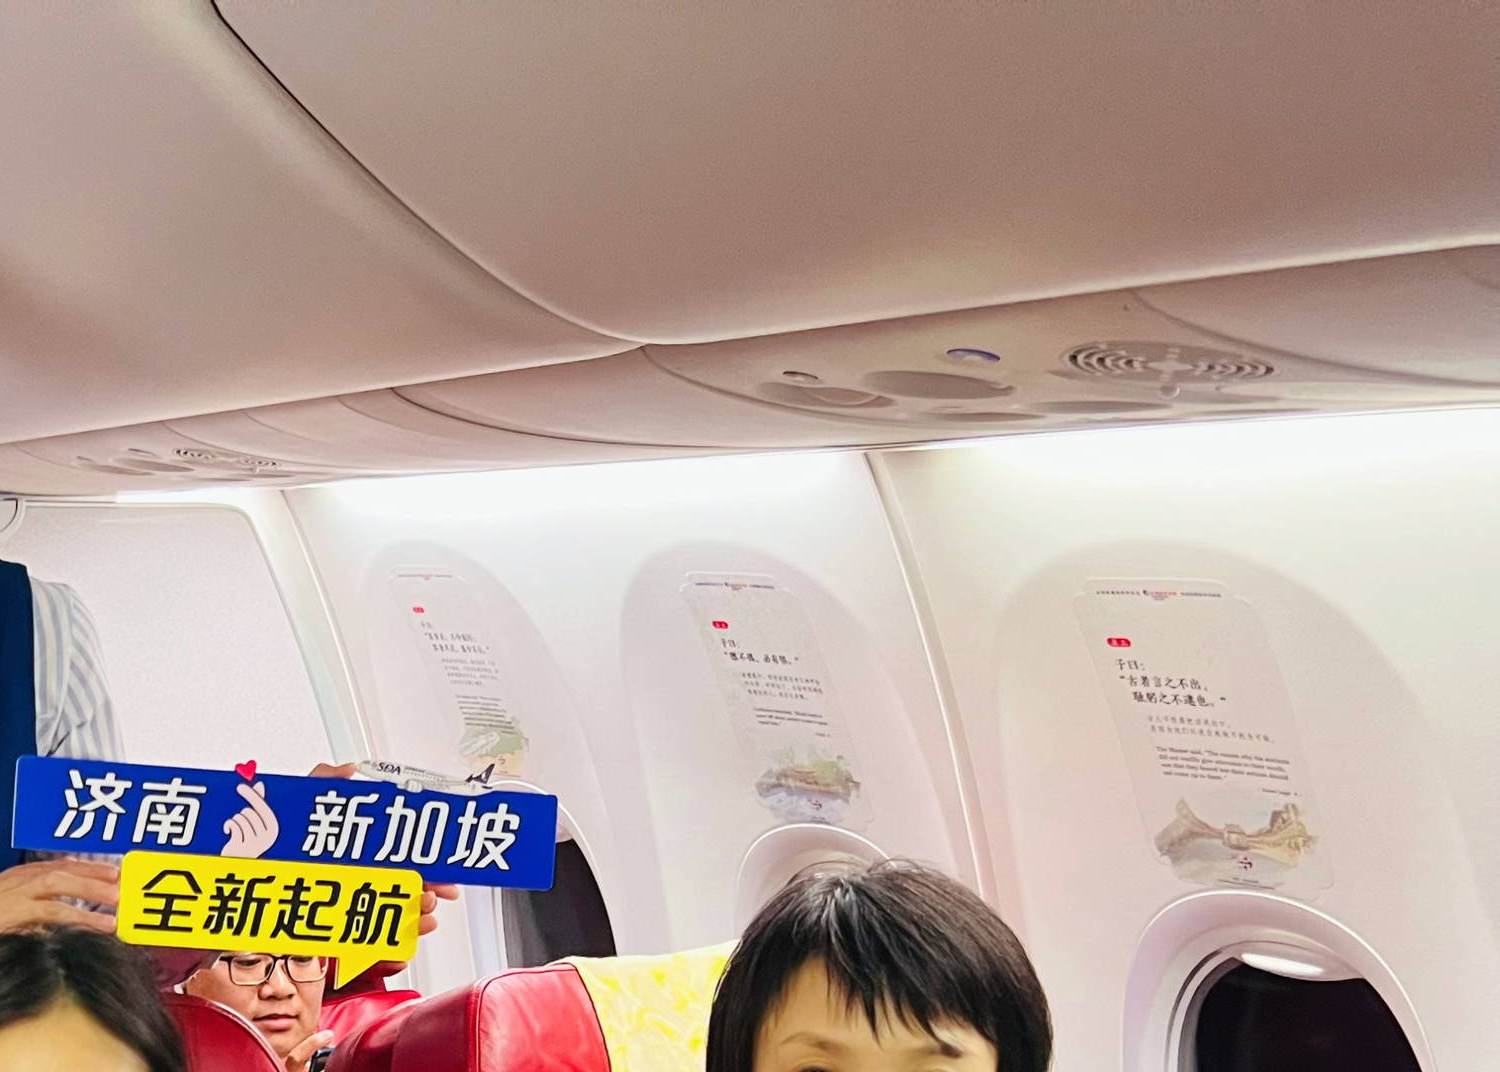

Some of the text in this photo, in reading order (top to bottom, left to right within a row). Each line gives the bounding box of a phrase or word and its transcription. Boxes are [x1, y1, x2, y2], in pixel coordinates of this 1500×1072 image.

[376, 762, 401, 776] SDA
[54, 769, 521, 872] 济南 新加坡
[133, 869, 411, 947] 全新起航
